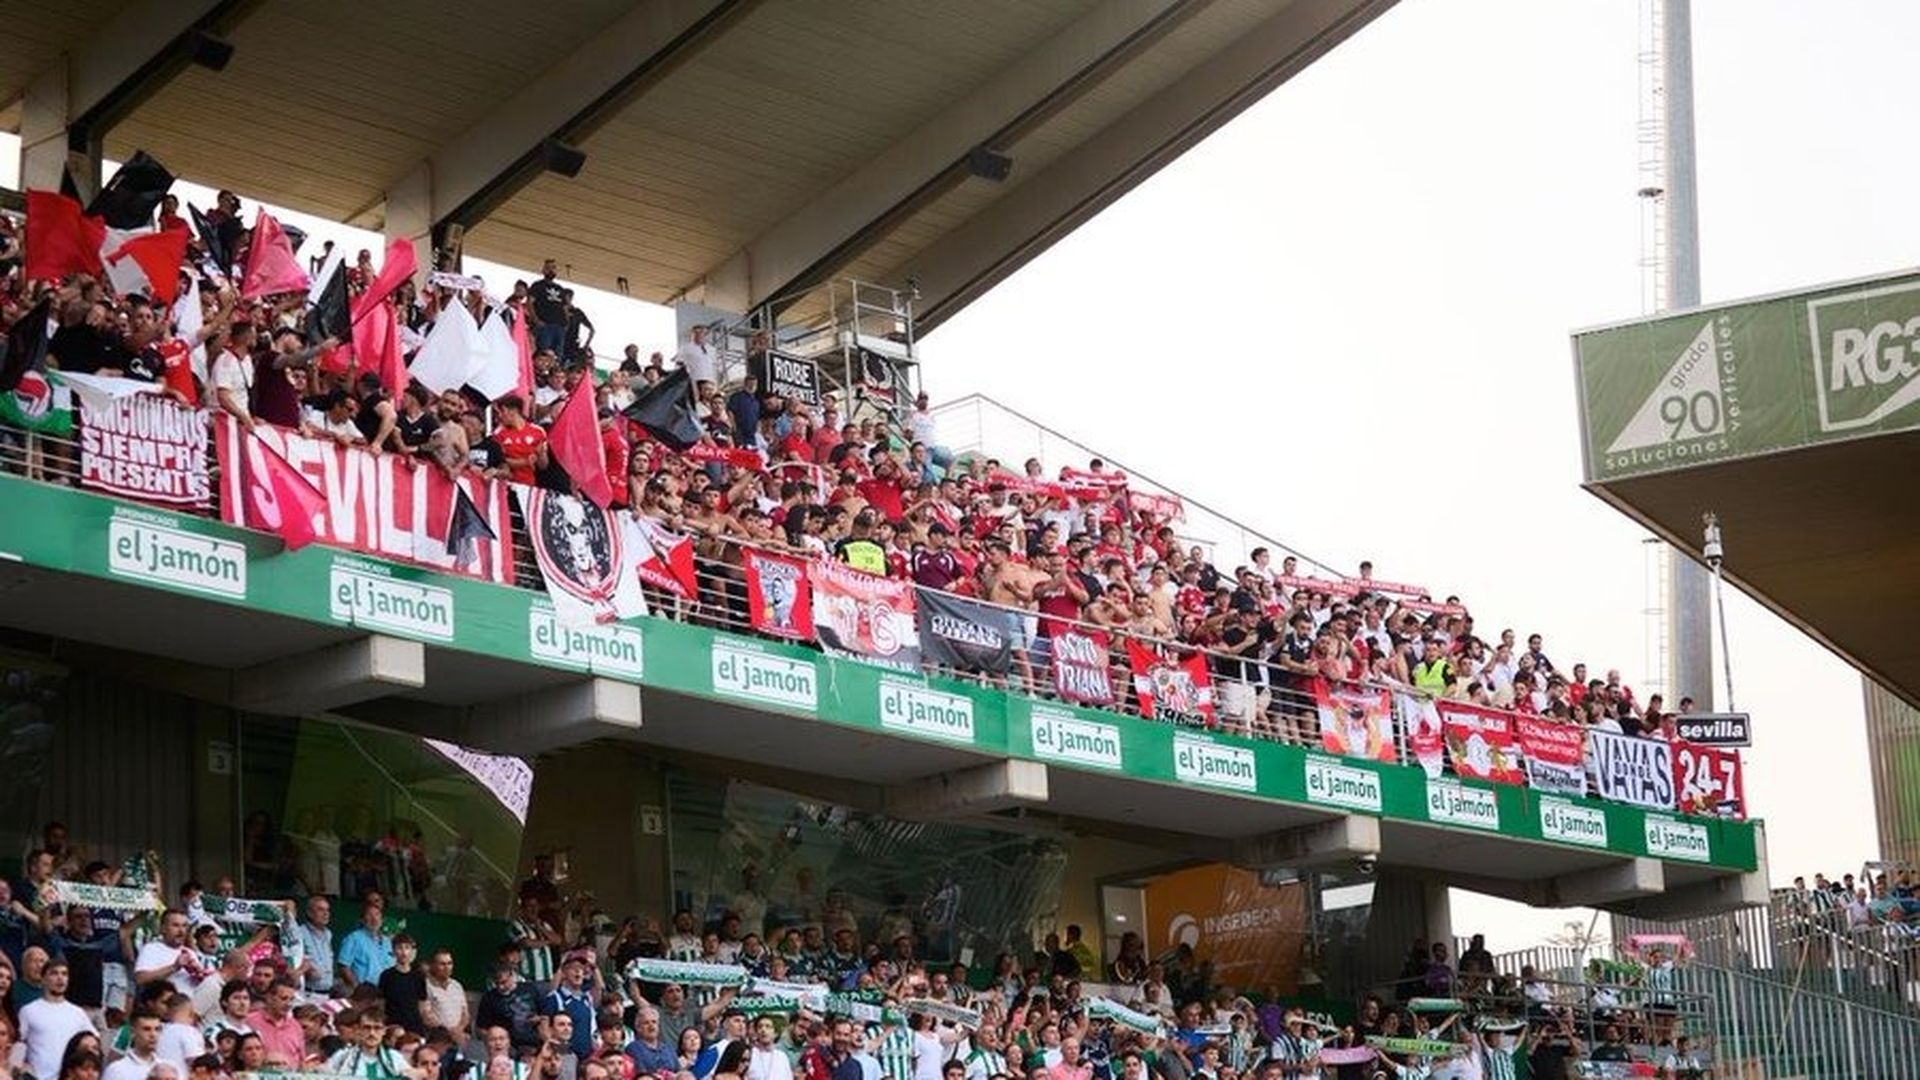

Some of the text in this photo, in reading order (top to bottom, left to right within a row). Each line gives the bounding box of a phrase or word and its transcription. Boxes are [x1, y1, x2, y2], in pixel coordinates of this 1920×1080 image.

[773, 356, 811, 387] ROBE
[1670, 340, 1709, 390] grado
[1720, 314, 1739, 432] verticales
[1660, 390, 1720, 440] 90
[82, 426, 208, 474] SIEMPRE
[1606, 439, 1729, 470] soluciones
[117, 530, 239, 582] el jamón
[338, 578, 447, 625] el jamón
[536, 622, 637, 662] el jamón
[719, 655, 736, 681] el
[742, 659, 811, 694] jamón
[1056, 661, 1113, 699] TRIANA
[885, 691, 970, 729] el jamón
[1036, 722, 1117, 756] el jamón
[1680, 721, 1743, 738] sevilla
[1179, 747, 1252, 778] el jamón
[1310, 769, 1377, 800] el jamón
[1431, 787, 1495, 818] el jamón
[1544, 808, 1603, 836] el jamón
[1650, 824, 1706, 851] el jamón
